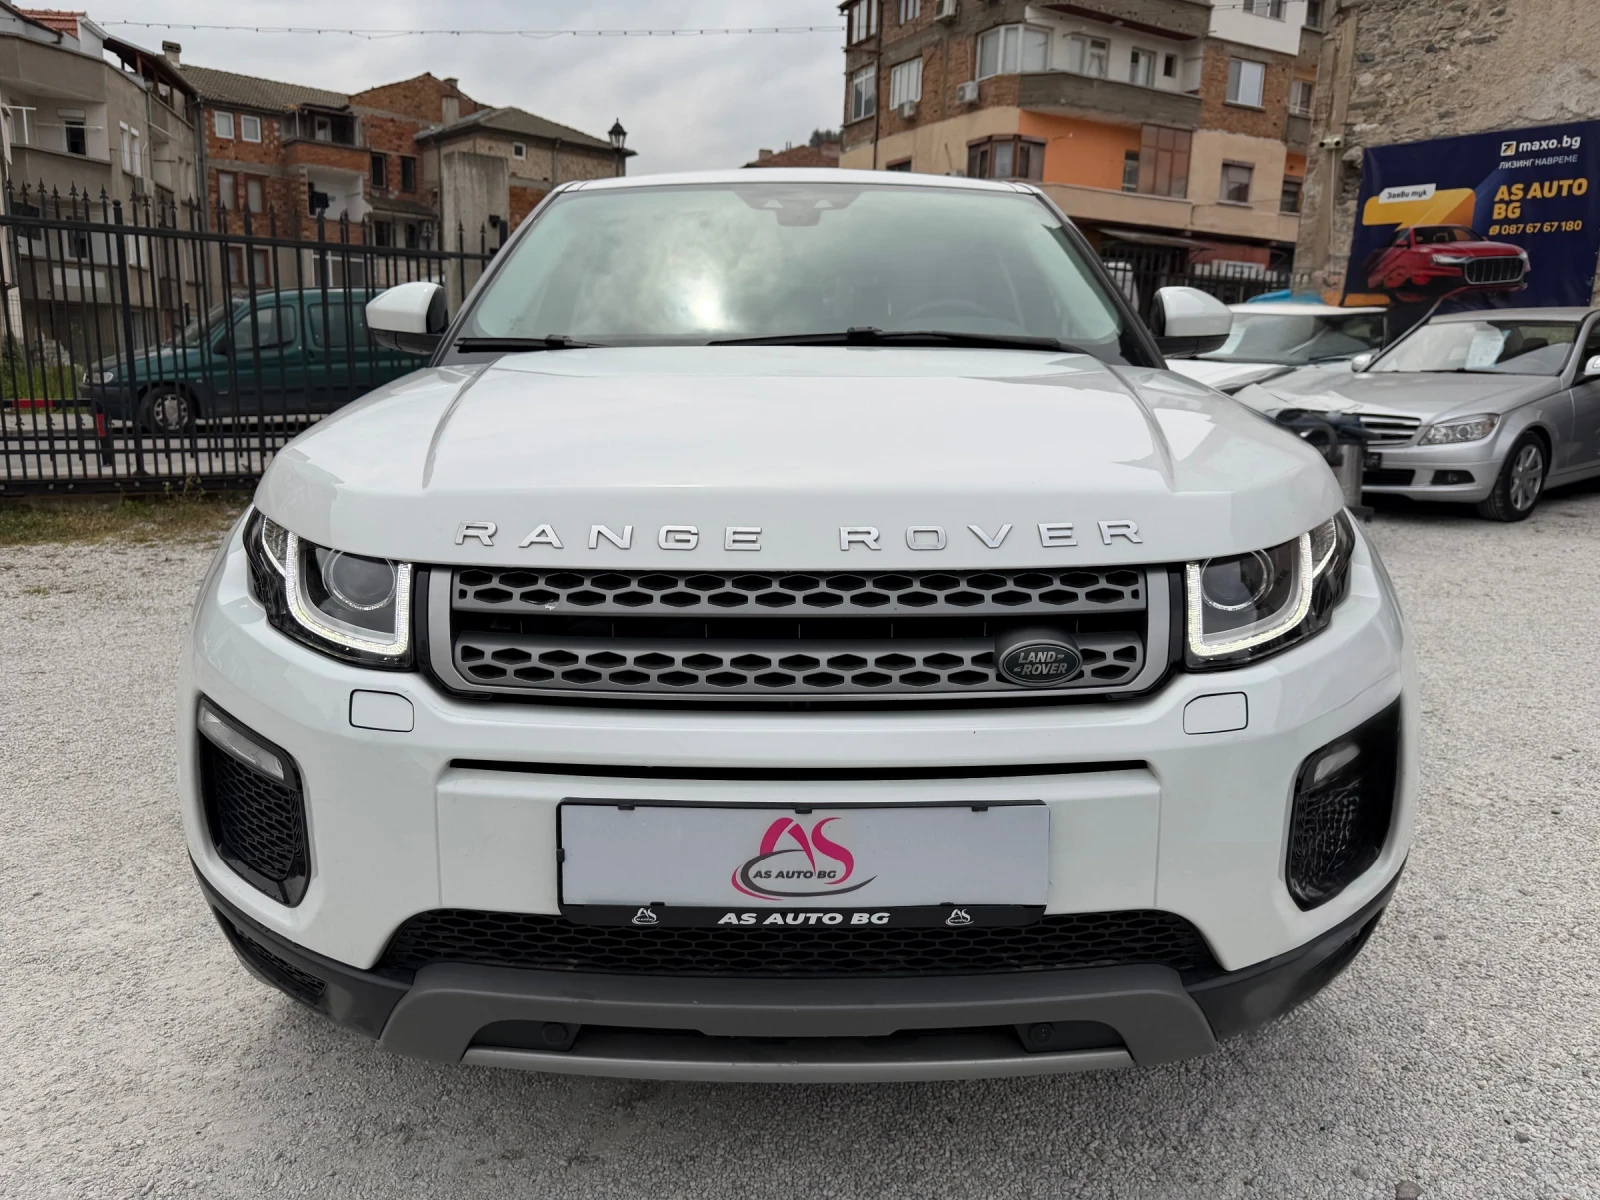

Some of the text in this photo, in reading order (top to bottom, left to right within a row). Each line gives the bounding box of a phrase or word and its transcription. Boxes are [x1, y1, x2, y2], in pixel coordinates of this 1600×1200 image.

[1519, 135, 1581, 153] maxo.bg
[1499, 154, 1578, 170] ЛИЗИНГ НАВРЕМЕ
[1495, 178, 1588, 202] AS AUTO
[1492, 203, 1521, 220] BG
[1501, 220, 1582, 235] 087 67 67 180
[454, 519, 1143, 552] RANGE ROVER
[1019, 652, 1056, 663] LAND
[1022, 663, 1067, 675] ROVER
[753, 870, 837, 879] AS AUTO BG
[717, 912, 890, 925] AS AUTO BG
